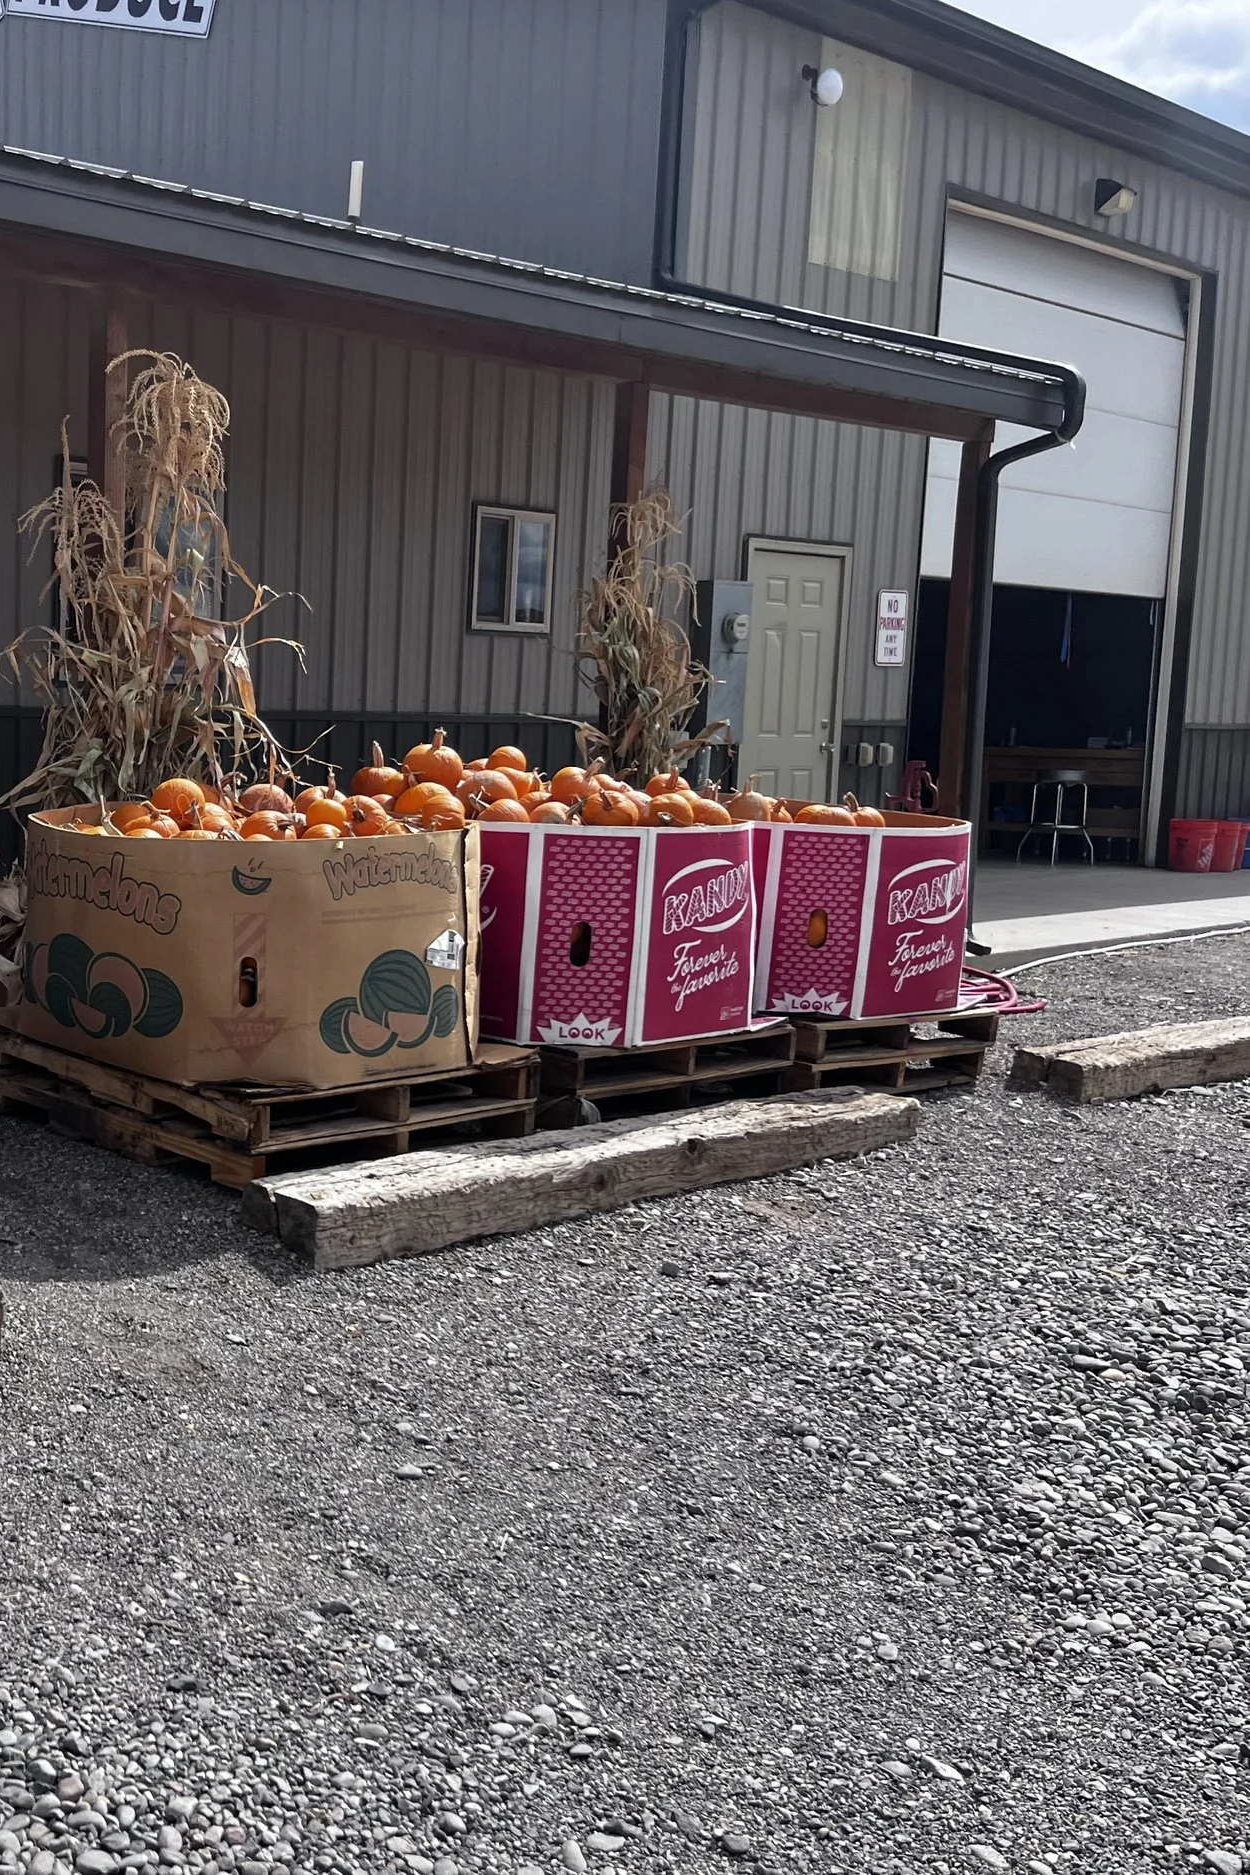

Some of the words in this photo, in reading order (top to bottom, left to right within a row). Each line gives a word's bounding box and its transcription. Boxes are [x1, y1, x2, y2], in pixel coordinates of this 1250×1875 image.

[887, 599, 899, 613] NO
[879, 616, 906, 631] PARKING
[885, 634, 897, 644] ANY
[883, 647, 898, 657] TIME
[663, 860, 748, 935] KANDY
[887, 860, 966, 925] KANDY
[888, 929, 947, 966] Forever
[666, 939, 727, 982] Forever
[894, 940, 955, 993] favorite
[675, 951, 740, 1012] favorite
[791, 999, 833, 1012] LOOK
[223, 1022, 275, 1034] WATCH
[559, 1026, 605, 1040] LOOK
